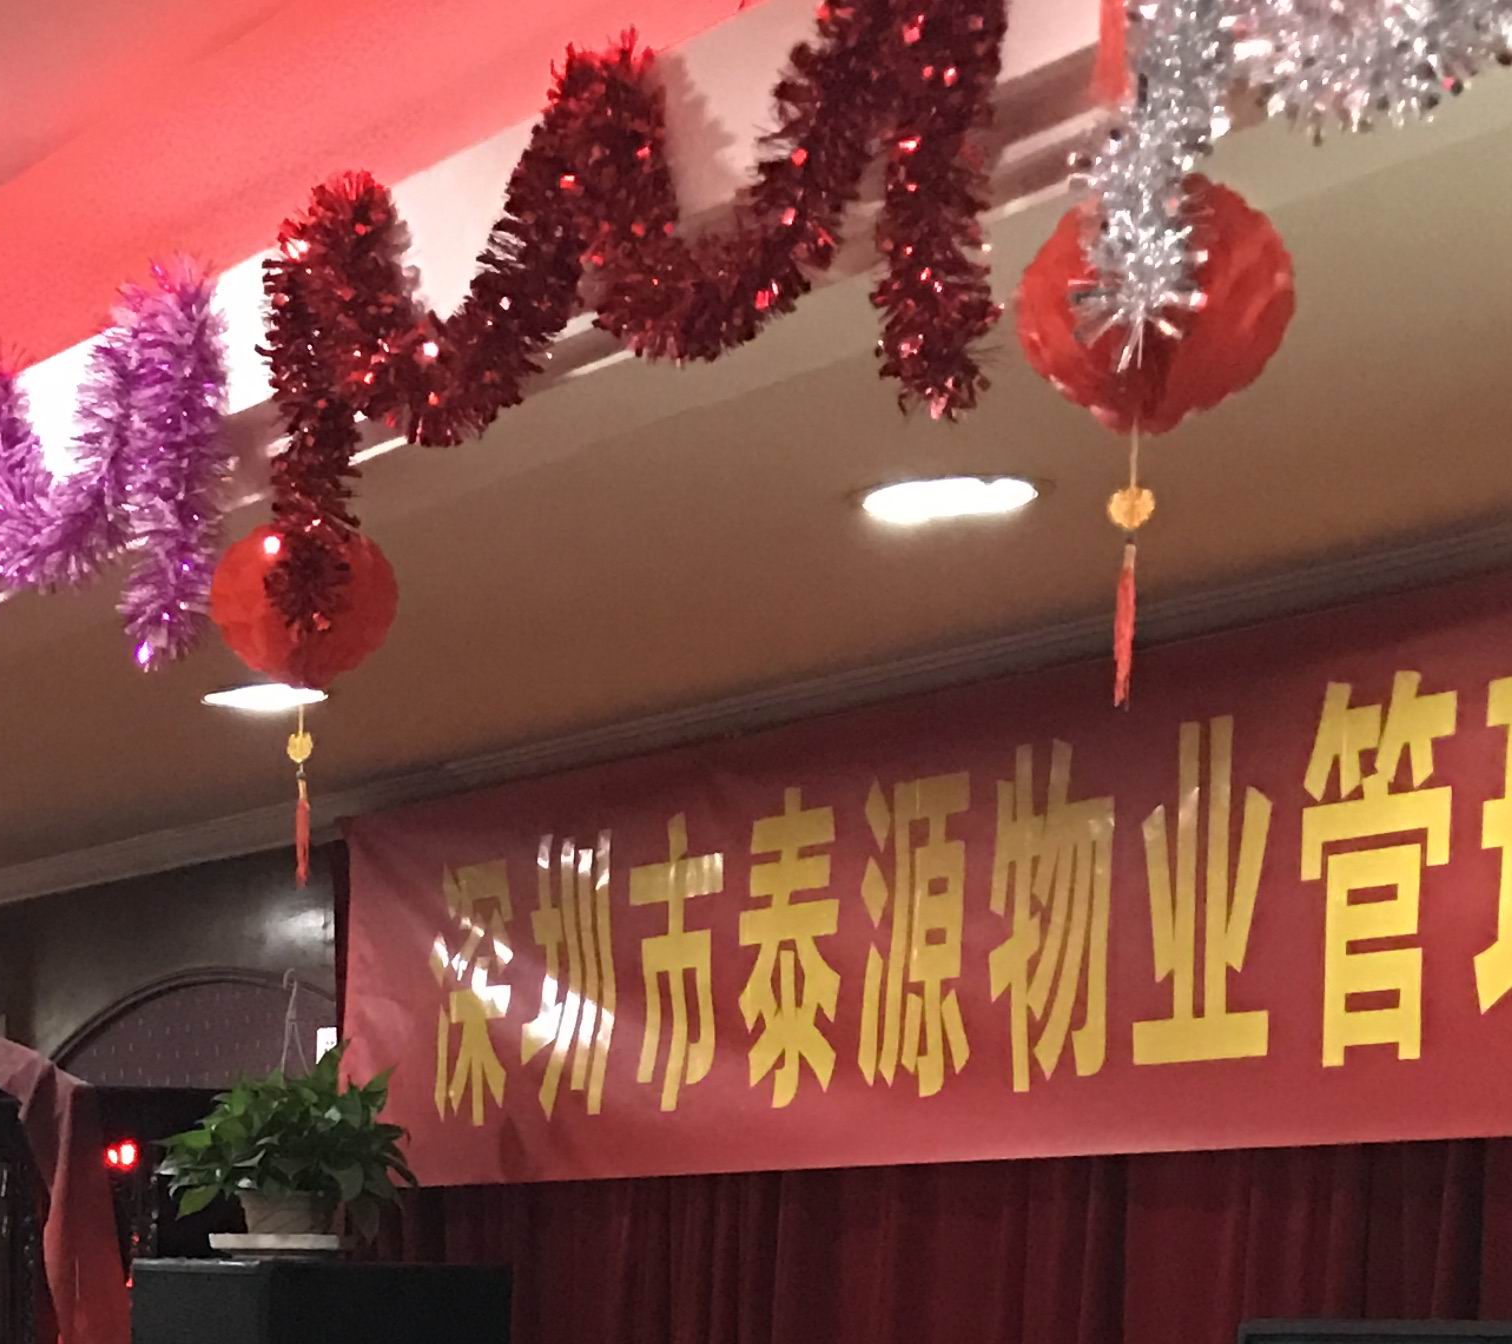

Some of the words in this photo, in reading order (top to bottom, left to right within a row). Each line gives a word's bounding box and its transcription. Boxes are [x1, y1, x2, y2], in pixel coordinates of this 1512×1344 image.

[431, 669, 1512, 1127] 深圳市泰源物业管
